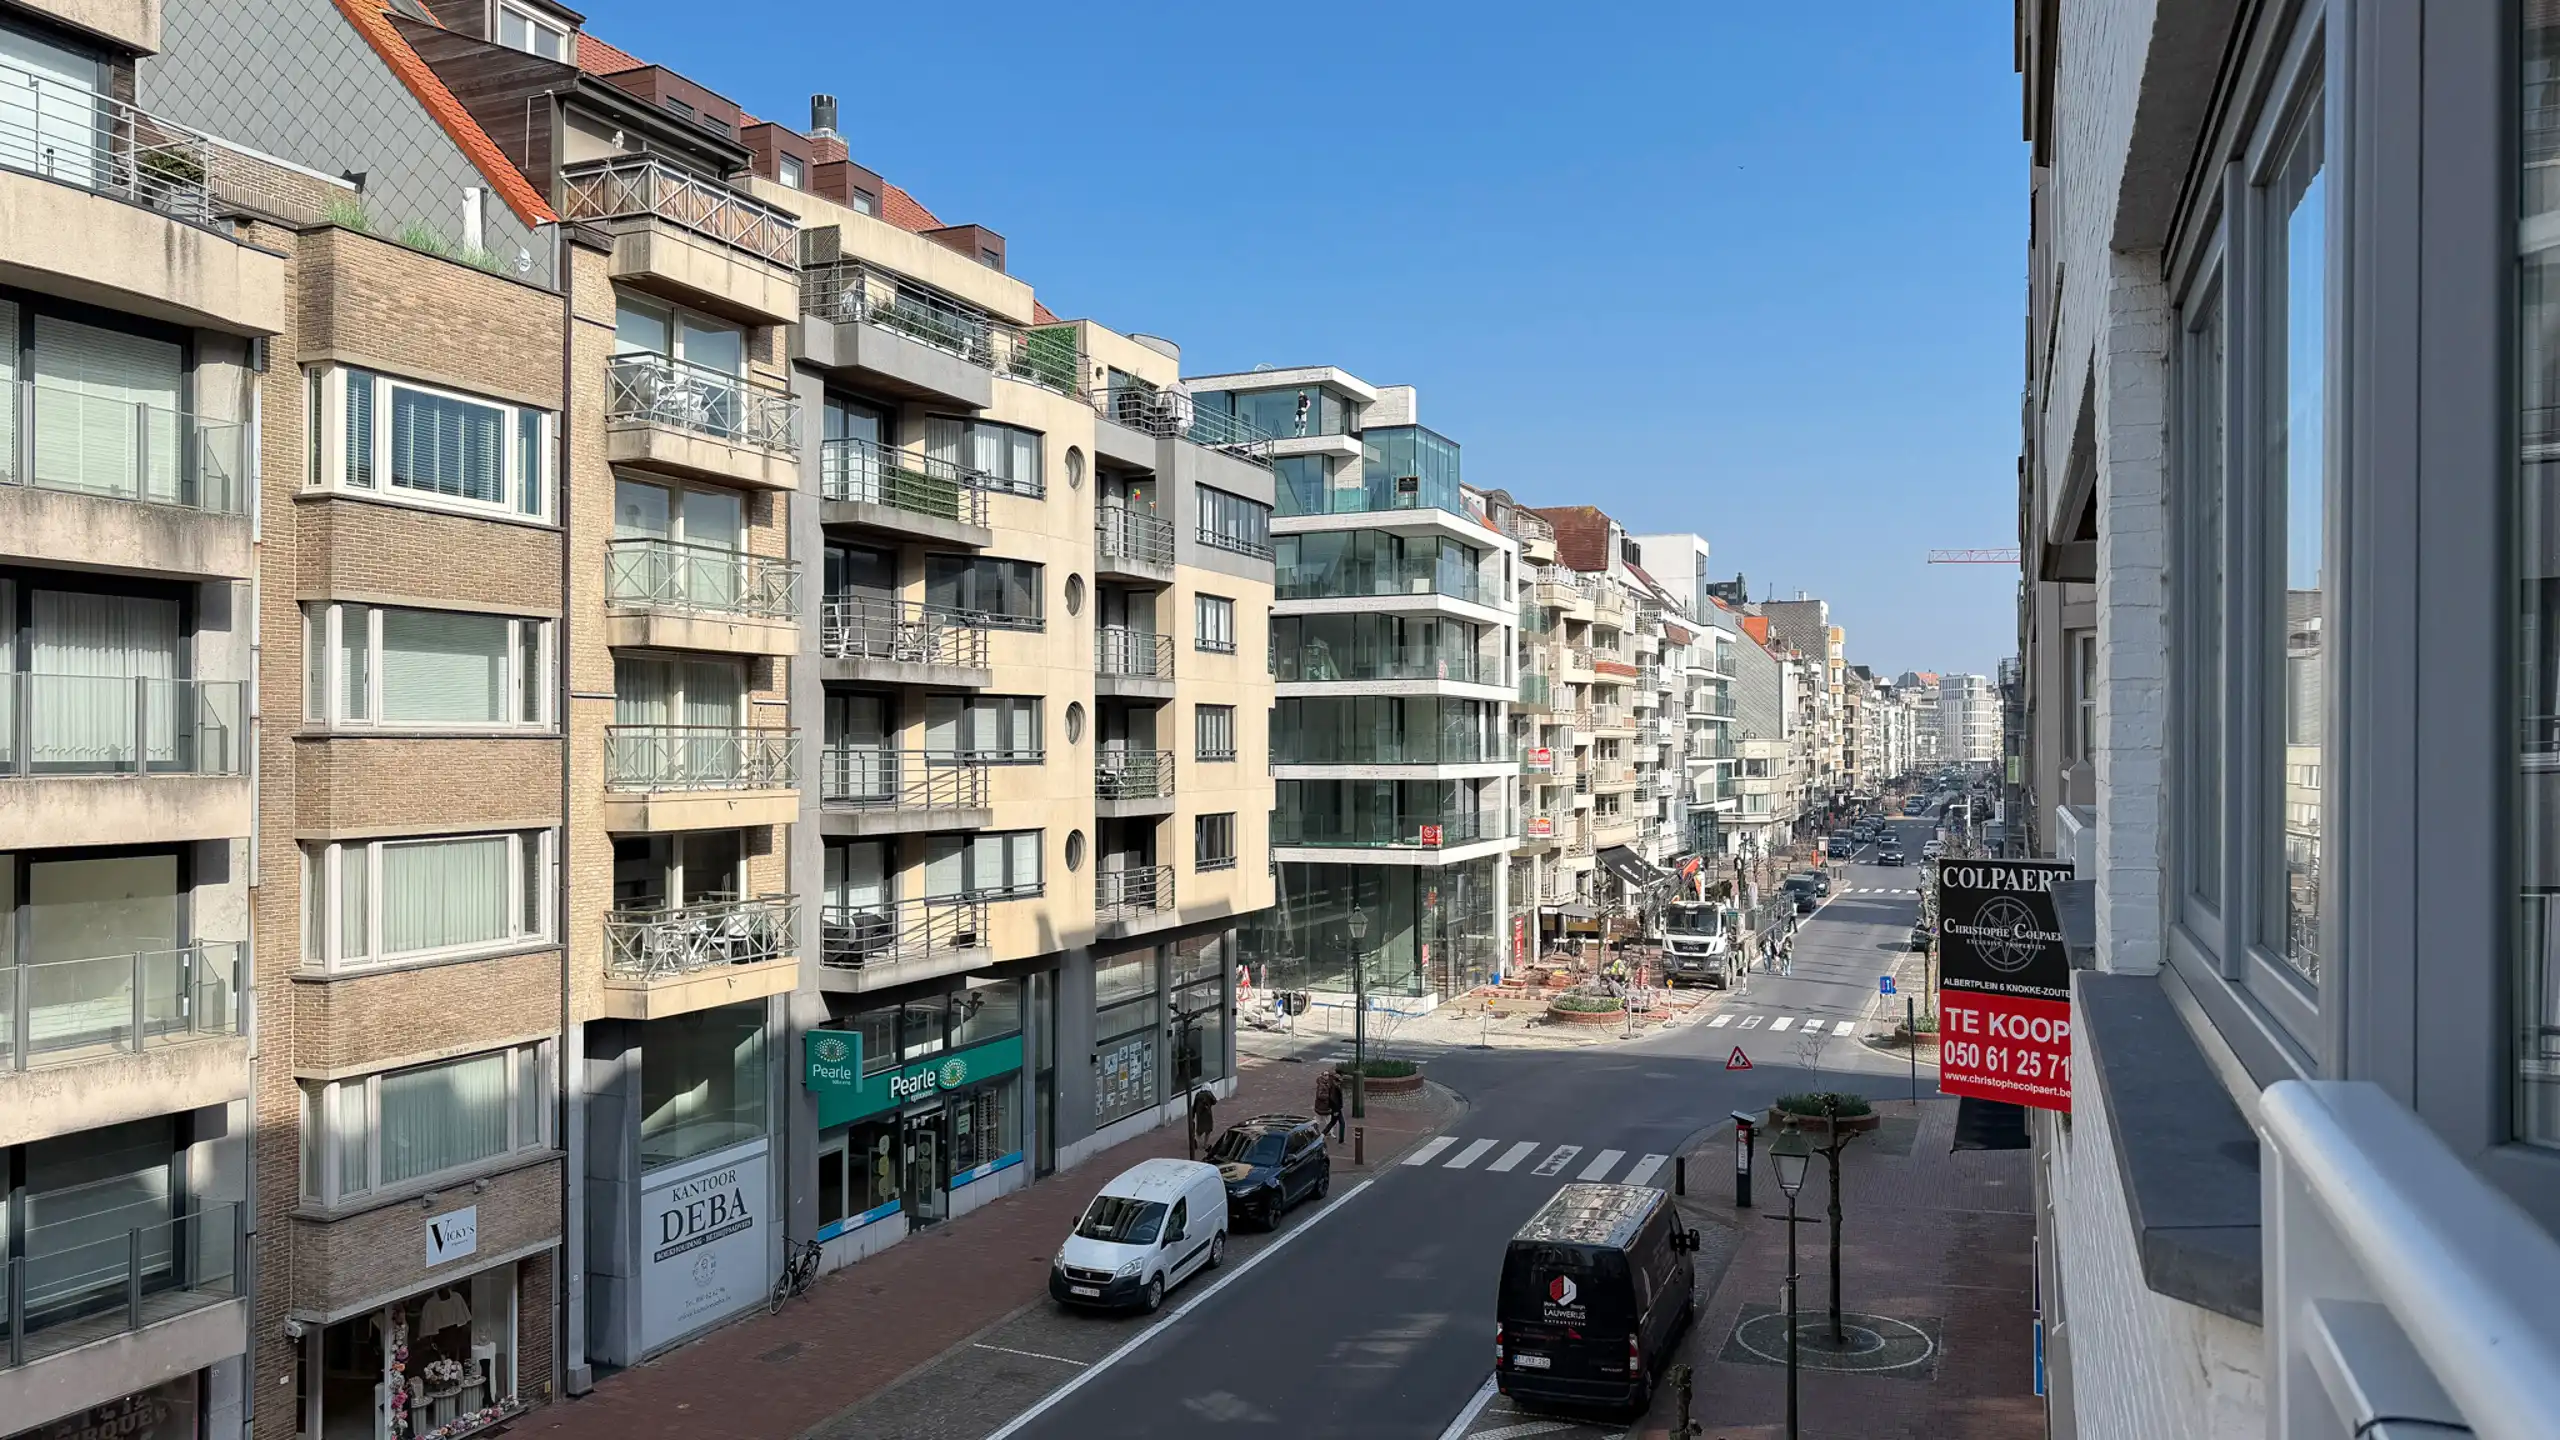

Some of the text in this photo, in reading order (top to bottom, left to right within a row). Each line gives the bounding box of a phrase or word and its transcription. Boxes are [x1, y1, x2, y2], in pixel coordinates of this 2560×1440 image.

[1942, 866, 2071, 892] COLPAERT
[2013, 923, 2064, 941] COLPAER
[1943, 977, 1998, 990] ALBERTPLEIN
[2006, 984, 2070, 998] KNOKKE-ZOUTE
[1945, 1007, 2070, 1044] TE KOOP
[812, 1064, 851, 1080] Pearle
[1944, 1040, 2070, 1081] 050 61 25 71
[890, 1068, 935, 1099] Pearle
[1944, 1072, 2070, 1098] www.christophecolpaert.be
[672, 1169, 736, 1202] KANTOOR
[660, 1187, 748, 1245] DEBA
